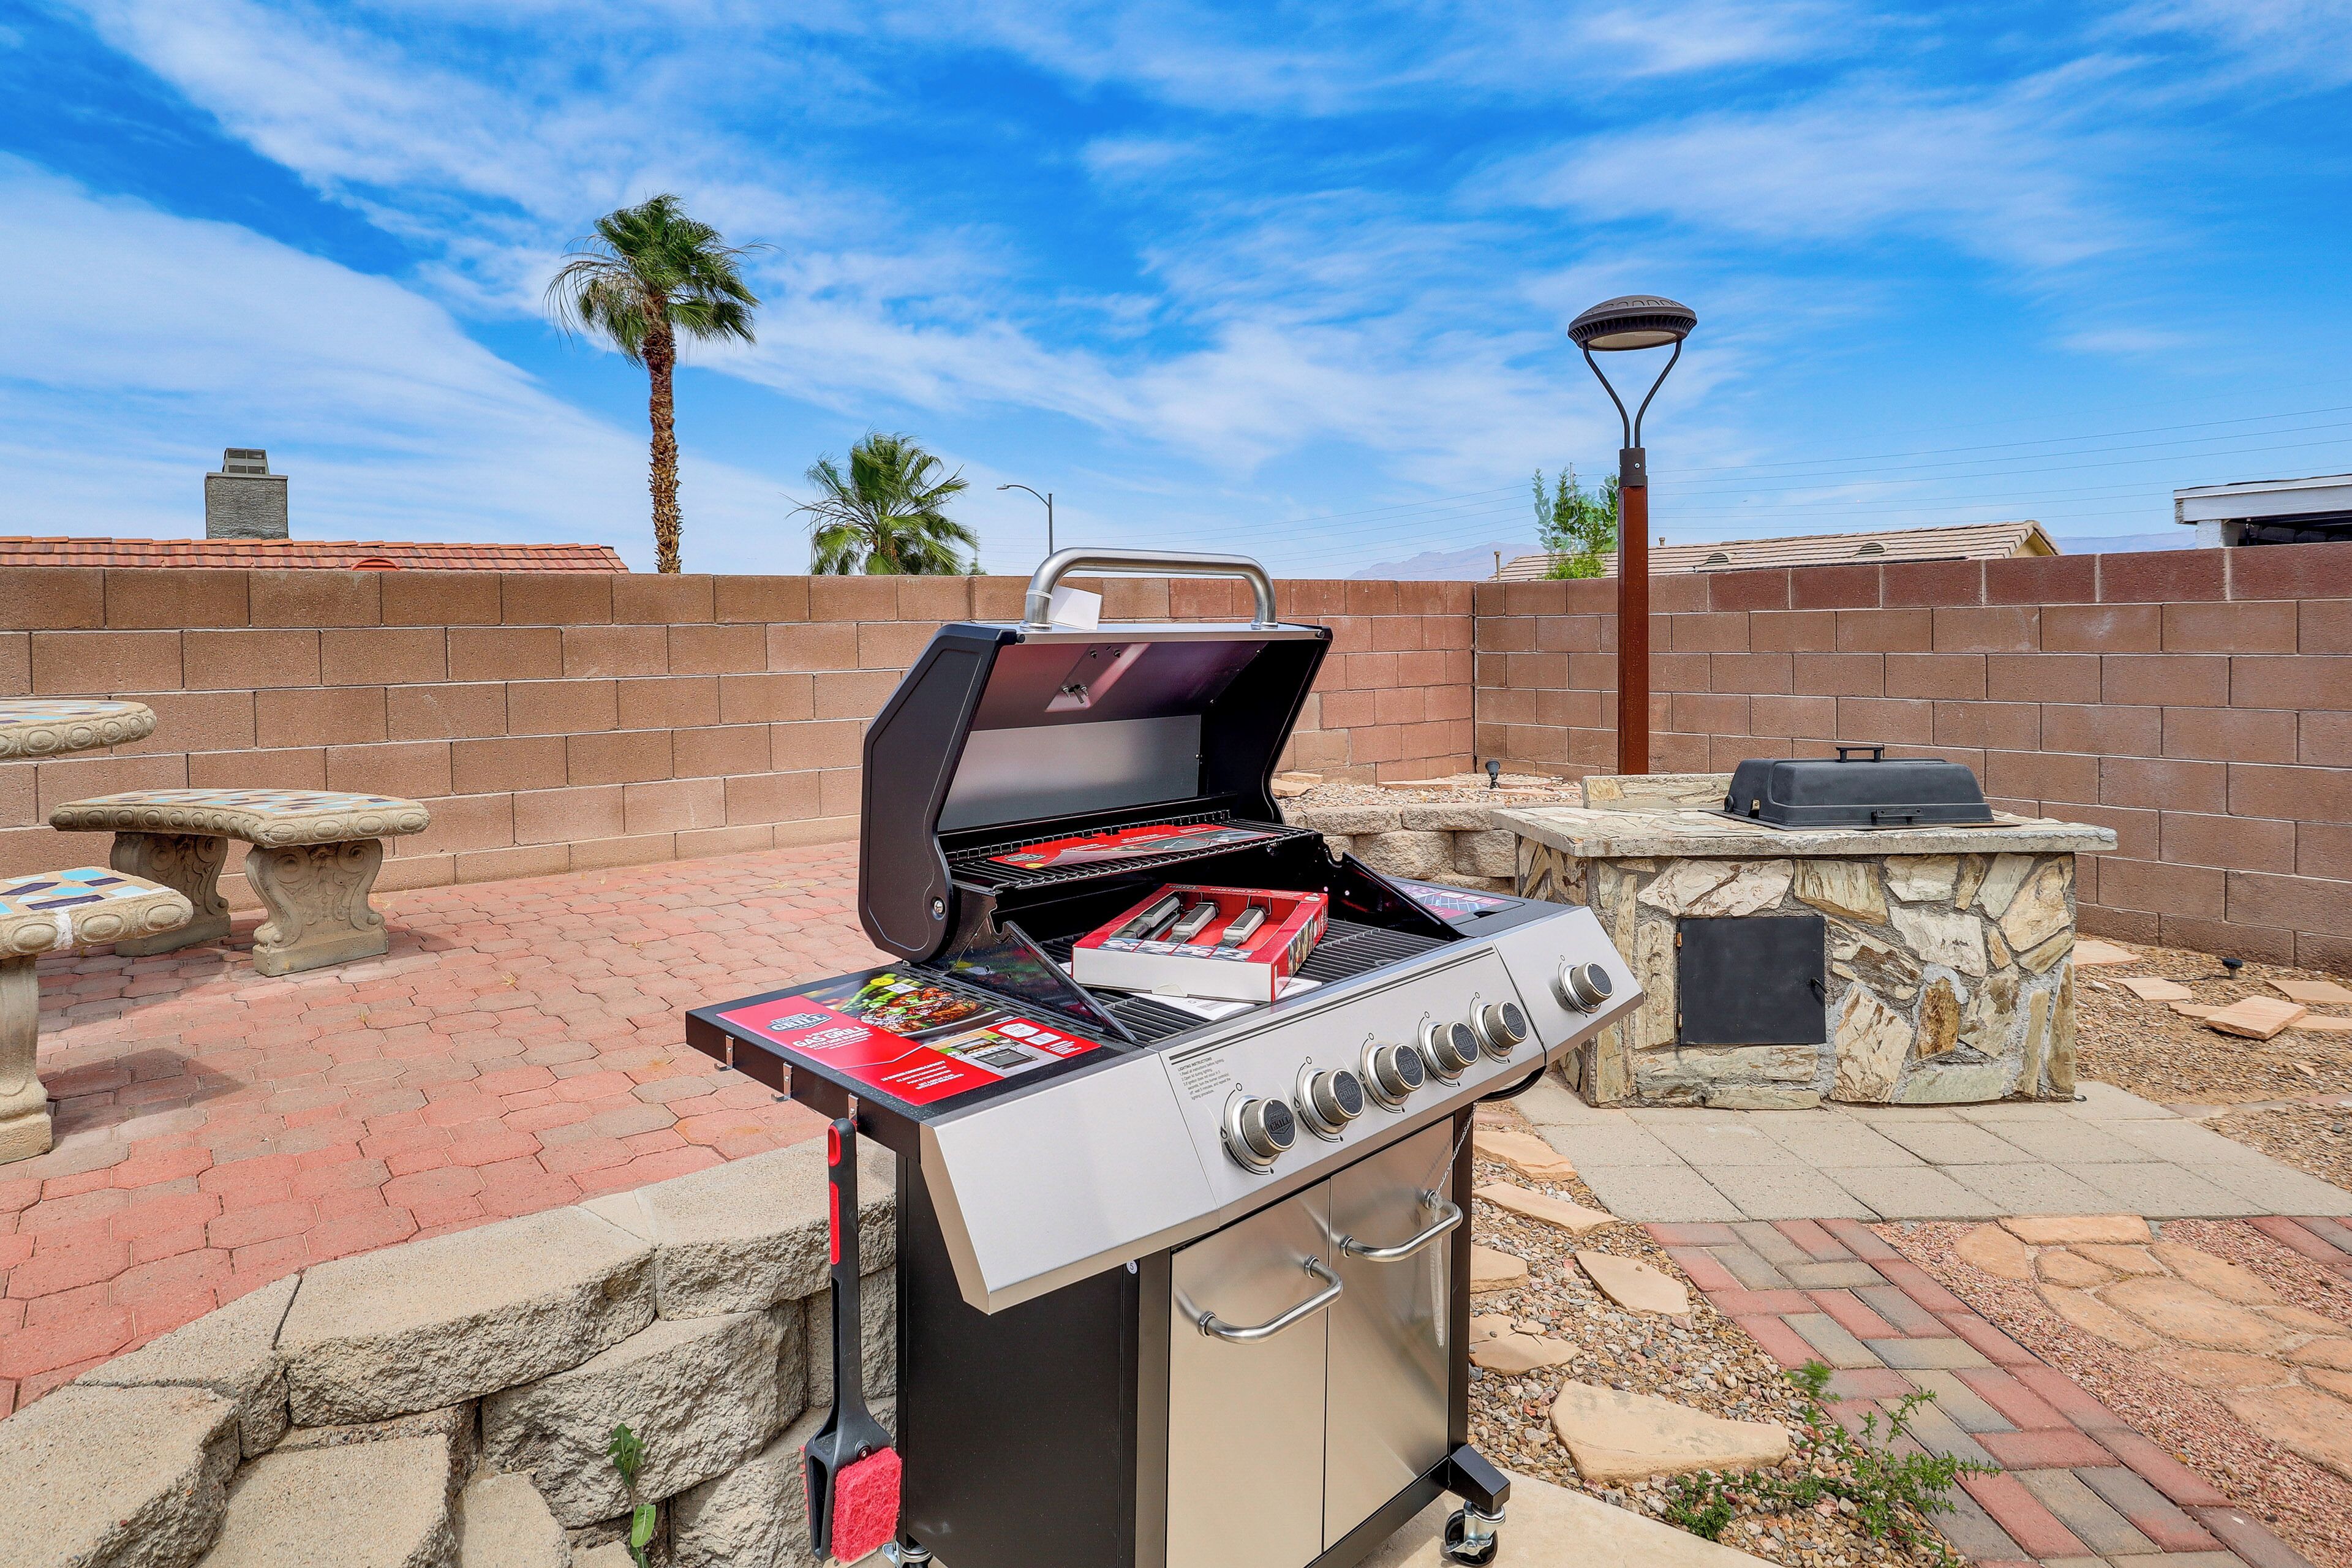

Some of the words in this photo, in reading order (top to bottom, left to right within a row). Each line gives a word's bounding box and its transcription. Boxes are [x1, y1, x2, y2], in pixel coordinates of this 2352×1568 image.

[772, 1014, 827, 1030] GRILL
[793, 1036, 826, 1047] GAS
[825, 1026, 869, 1039] GRILL
[842, 1031, 870, 1039] BURNER
[1191, 1057, 1212, 1066] INSTRUCTIONS
[1401, 1060, 1419, 1072] GRILL
[1339, 1085, 1358, 1101] GRILL
[1270, 1114, 1291, 1132] GRILL
